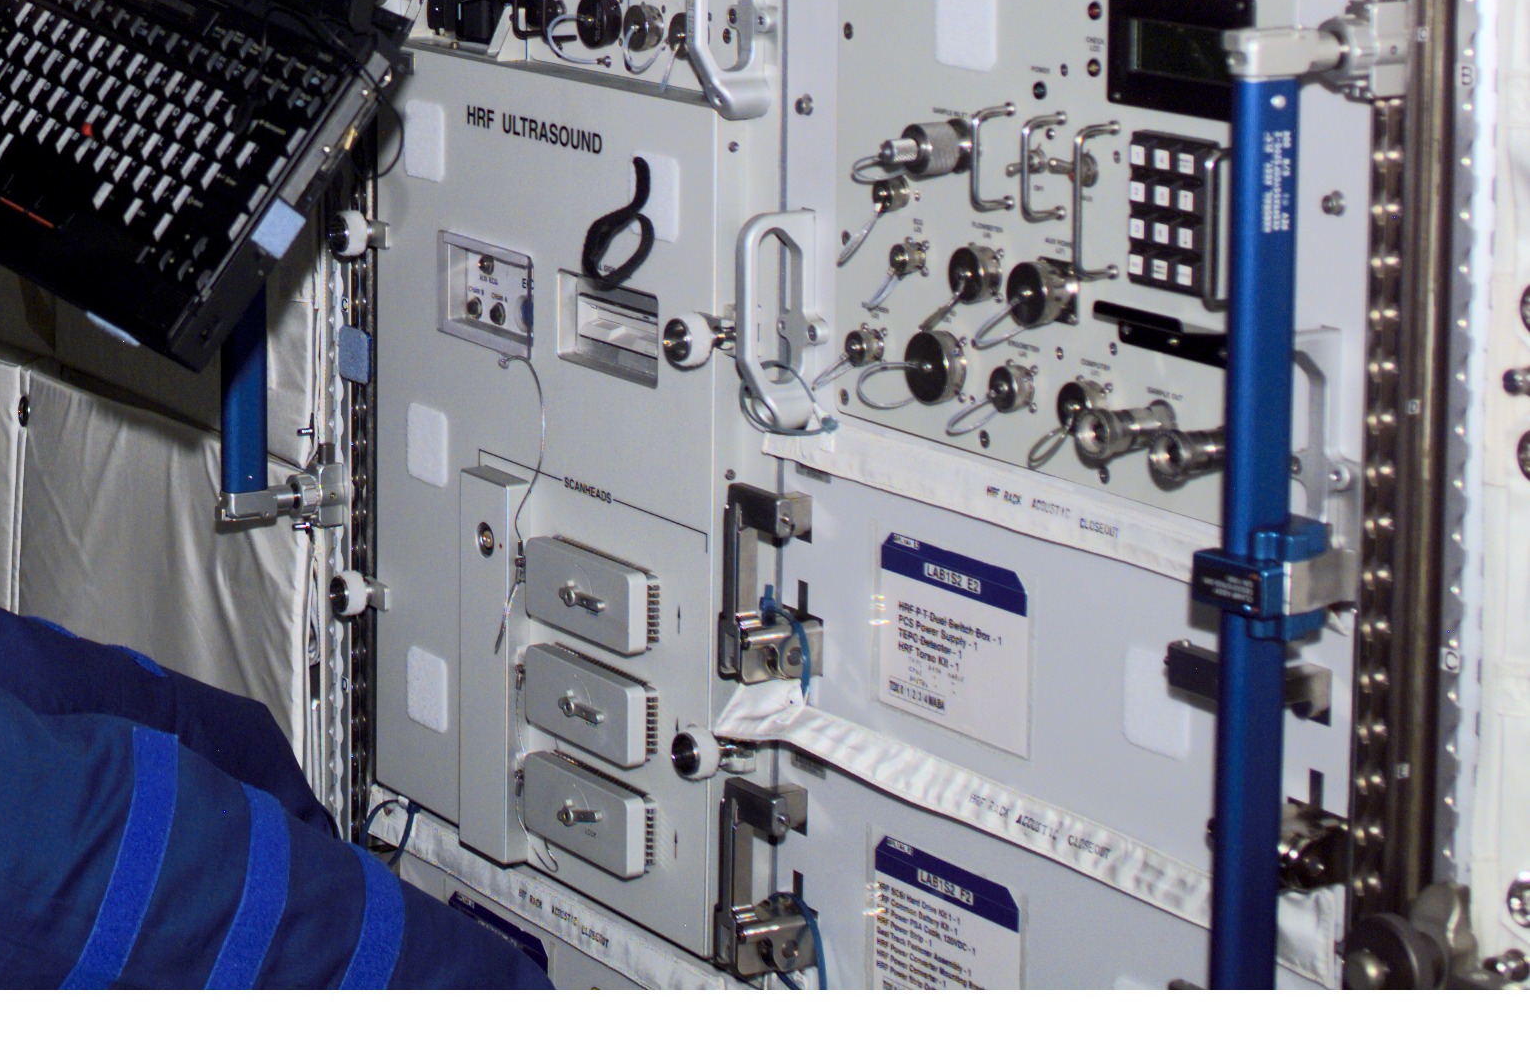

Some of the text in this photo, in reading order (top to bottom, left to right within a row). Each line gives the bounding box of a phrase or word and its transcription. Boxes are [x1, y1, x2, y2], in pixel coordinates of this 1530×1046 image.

[467, 104, 602, 155] HRF ULTRASOUND
[564, 476, 613, 504] SCANHEADS
[1031, 498, 1070, 519] ACOUSTIC
[1079, 517, 1119, 538] CLOSEOUT
[926, 565, 979, 592] LAB1S2 E2
[898, 614, 914, 629] PCS
[915, 620, 939, 636] Power
[940, 629, 966, 649] Supply
[929, 611, 947, 626] Dual
[948, 618, 974, 635] Switch
[975, 627, 990, 642] Box
[898, 641, 914, 654] HRF
[915, 647, 936, 663] Torso
[1016, 814, 1059, 840] ACOUSTIC
[1068, 834, 1111, 859] CLOSEOUT
[891, 887, 905, 899] SCSI
[906, 894, 920, 907] Hard
[921, 901, 937, 915] Drive
[920, 870, 972, 903] LAB1S2 F2
[890, 910, 909, 923] Power
[891, 898, 917, 915] Common
[918, 910, 940, 928] Battery
[581, 925, 609, 948] CLOSEOUT
[890, 921, 908, 935] Power
